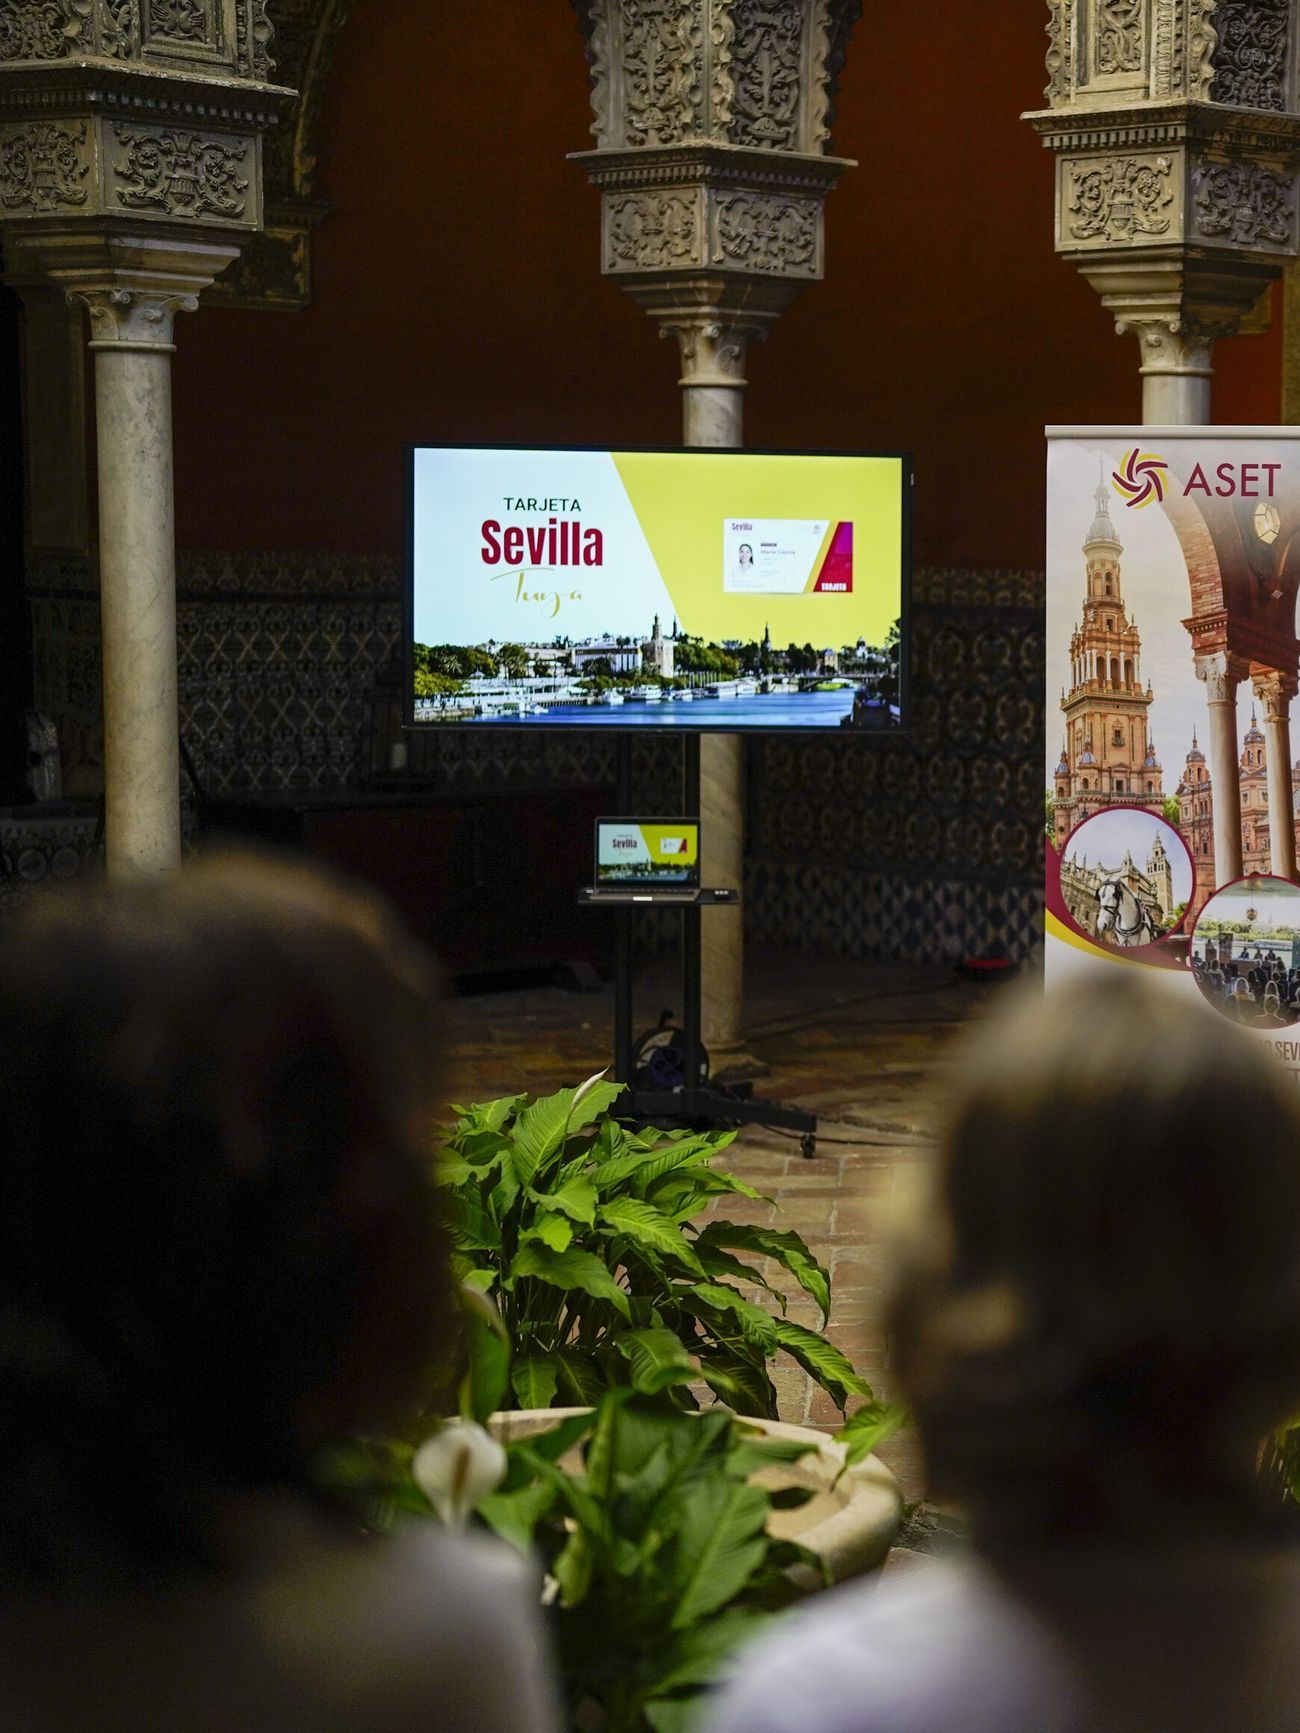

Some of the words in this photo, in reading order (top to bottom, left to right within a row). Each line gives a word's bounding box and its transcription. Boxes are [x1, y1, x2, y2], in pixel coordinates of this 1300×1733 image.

[1182, 462, 1281, 497] ASET
[503, 497, 582, 512] TARJETA
[732, 522, 753, 531] Sevilla
[481, 517, 603, 566] Sevilla
[821, 582, 847, 591] TARJETA
[612, 839, 638, 848] Sevilla
